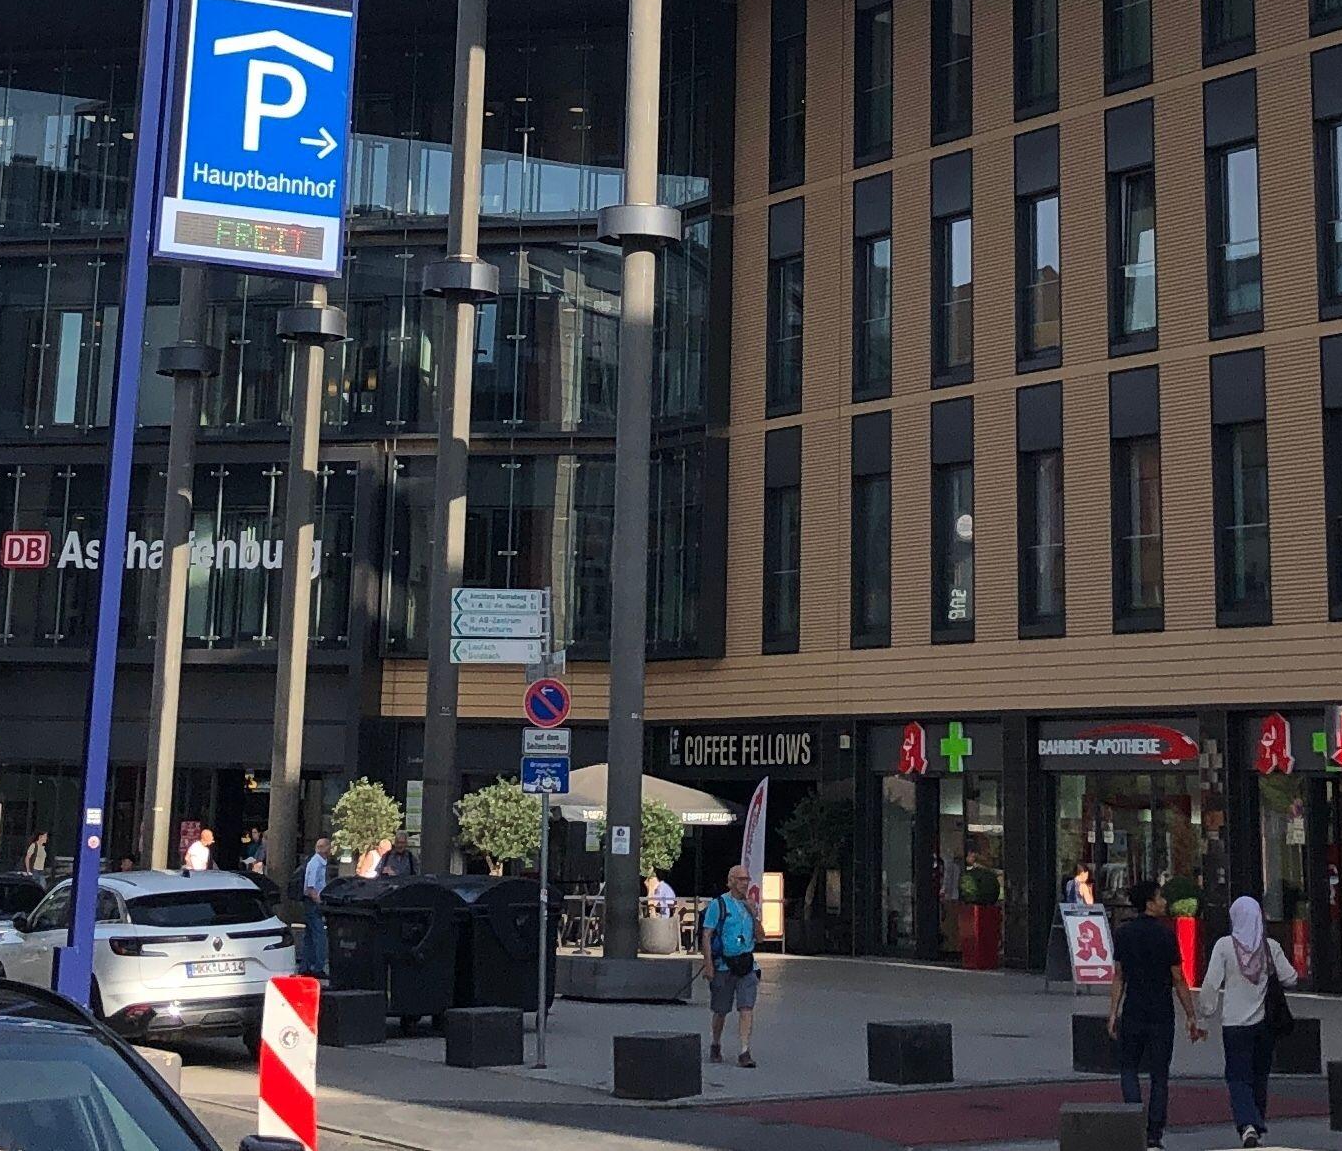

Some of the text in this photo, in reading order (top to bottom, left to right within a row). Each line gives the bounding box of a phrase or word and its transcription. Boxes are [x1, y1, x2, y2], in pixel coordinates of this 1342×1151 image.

[243, 59, 307, 152] P
[192, 161, 337, 199] Hauptbahnhof
[6, 536, 43, 563] DB
[684, 732, 811, 766] COFFEE FELLOWS
[1038, 737, 1162, 756] BAHNHOF-APOTHEKE
